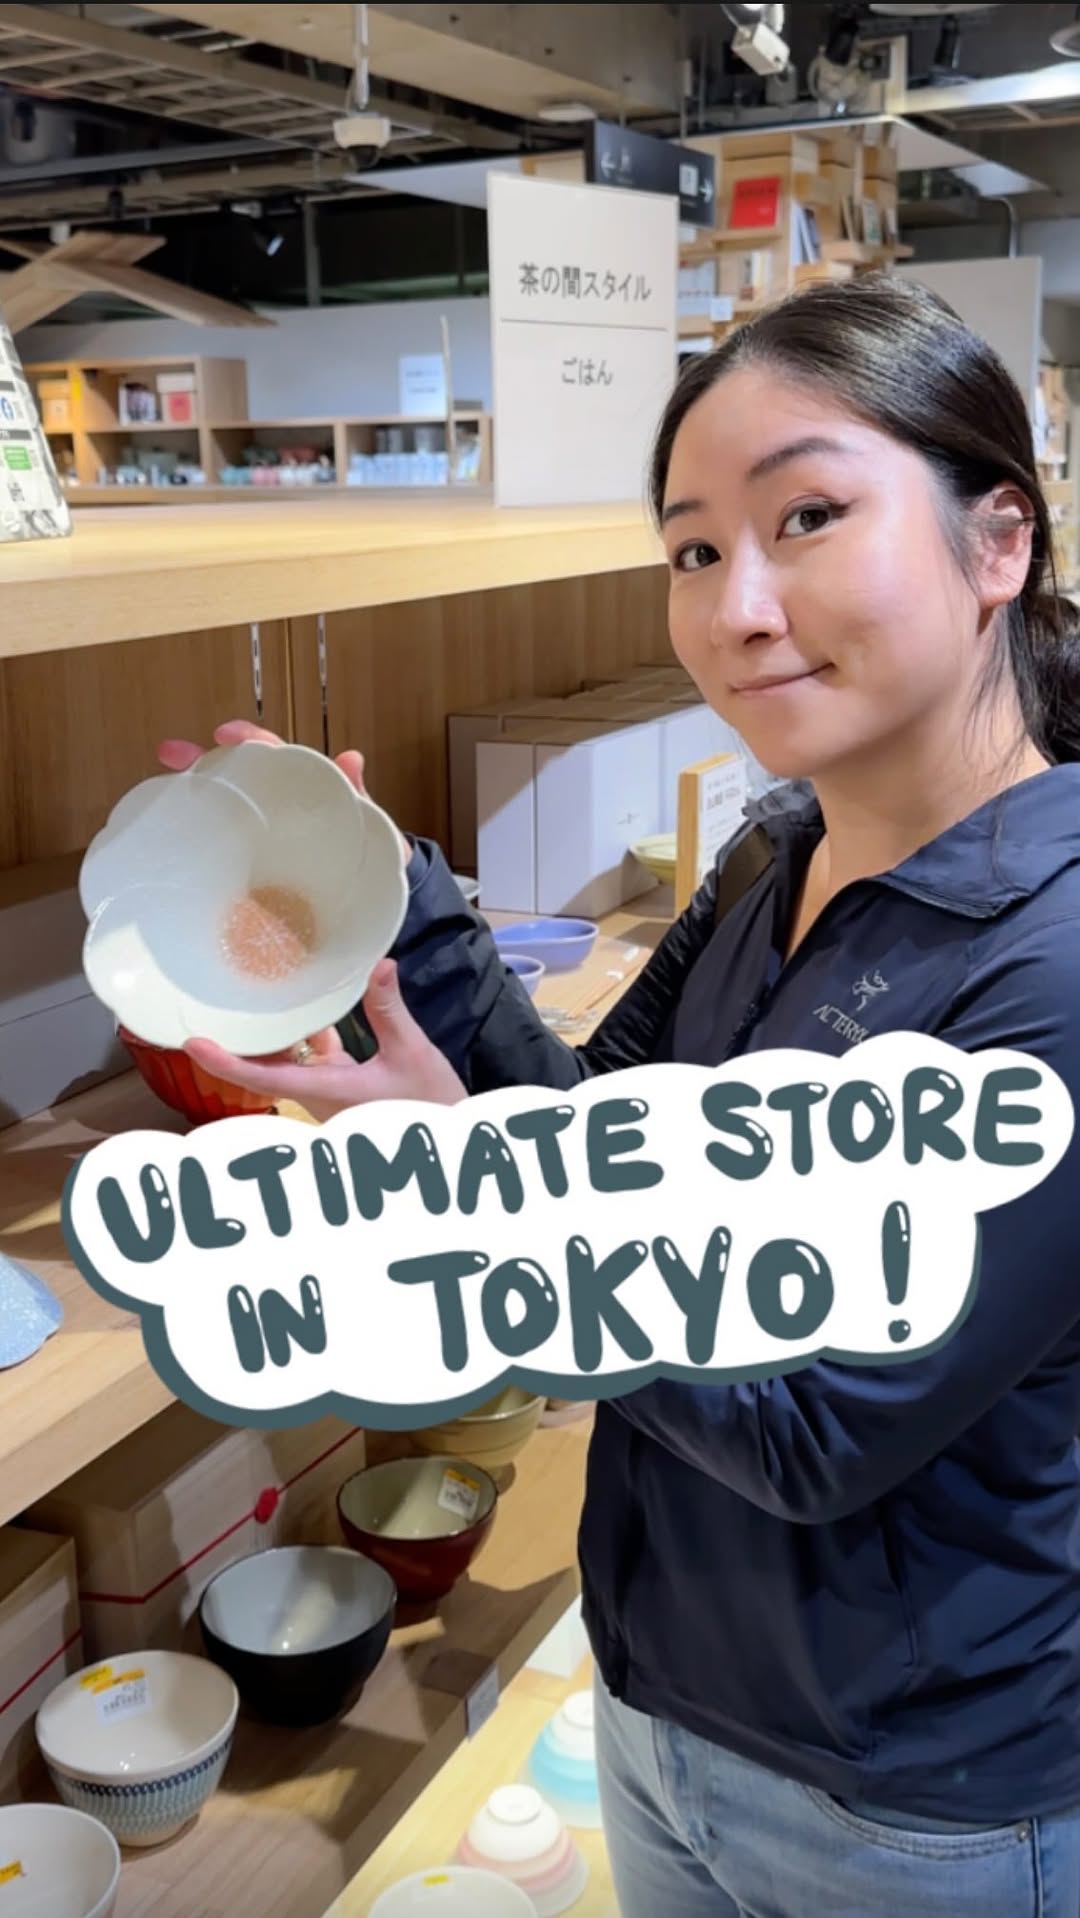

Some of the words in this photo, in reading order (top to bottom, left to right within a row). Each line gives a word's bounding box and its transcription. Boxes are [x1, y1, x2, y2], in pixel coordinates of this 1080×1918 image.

[518, 261, 652, 302] 茶の間スタイル
[561, 356, 613, 386] ごはん
